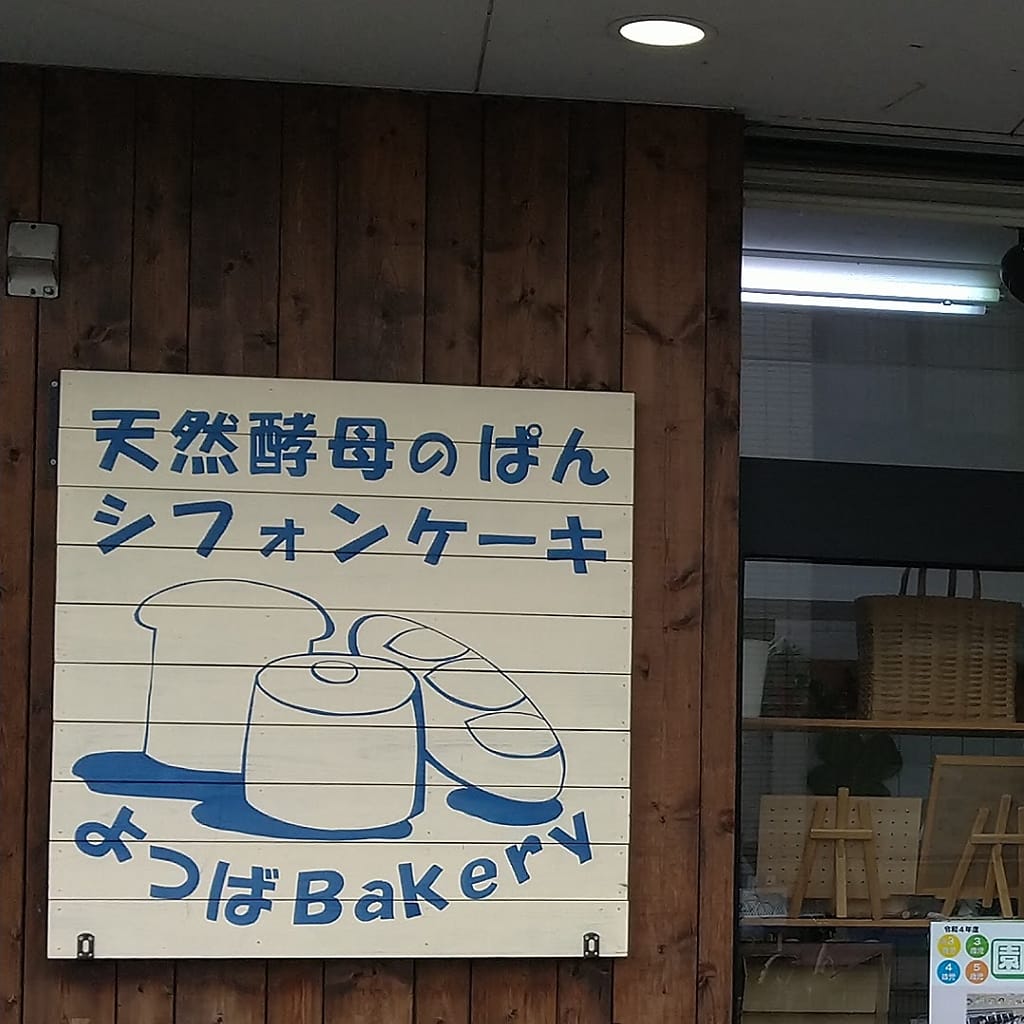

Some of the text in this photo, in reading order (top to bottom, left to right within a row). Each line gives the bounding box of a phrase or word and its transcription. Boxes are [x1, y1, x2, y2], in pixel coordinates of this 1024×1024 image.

[91, 409, 611, 485] 天然酵母のぱん
[93, 494, 608, 575] シフォンケーキ
